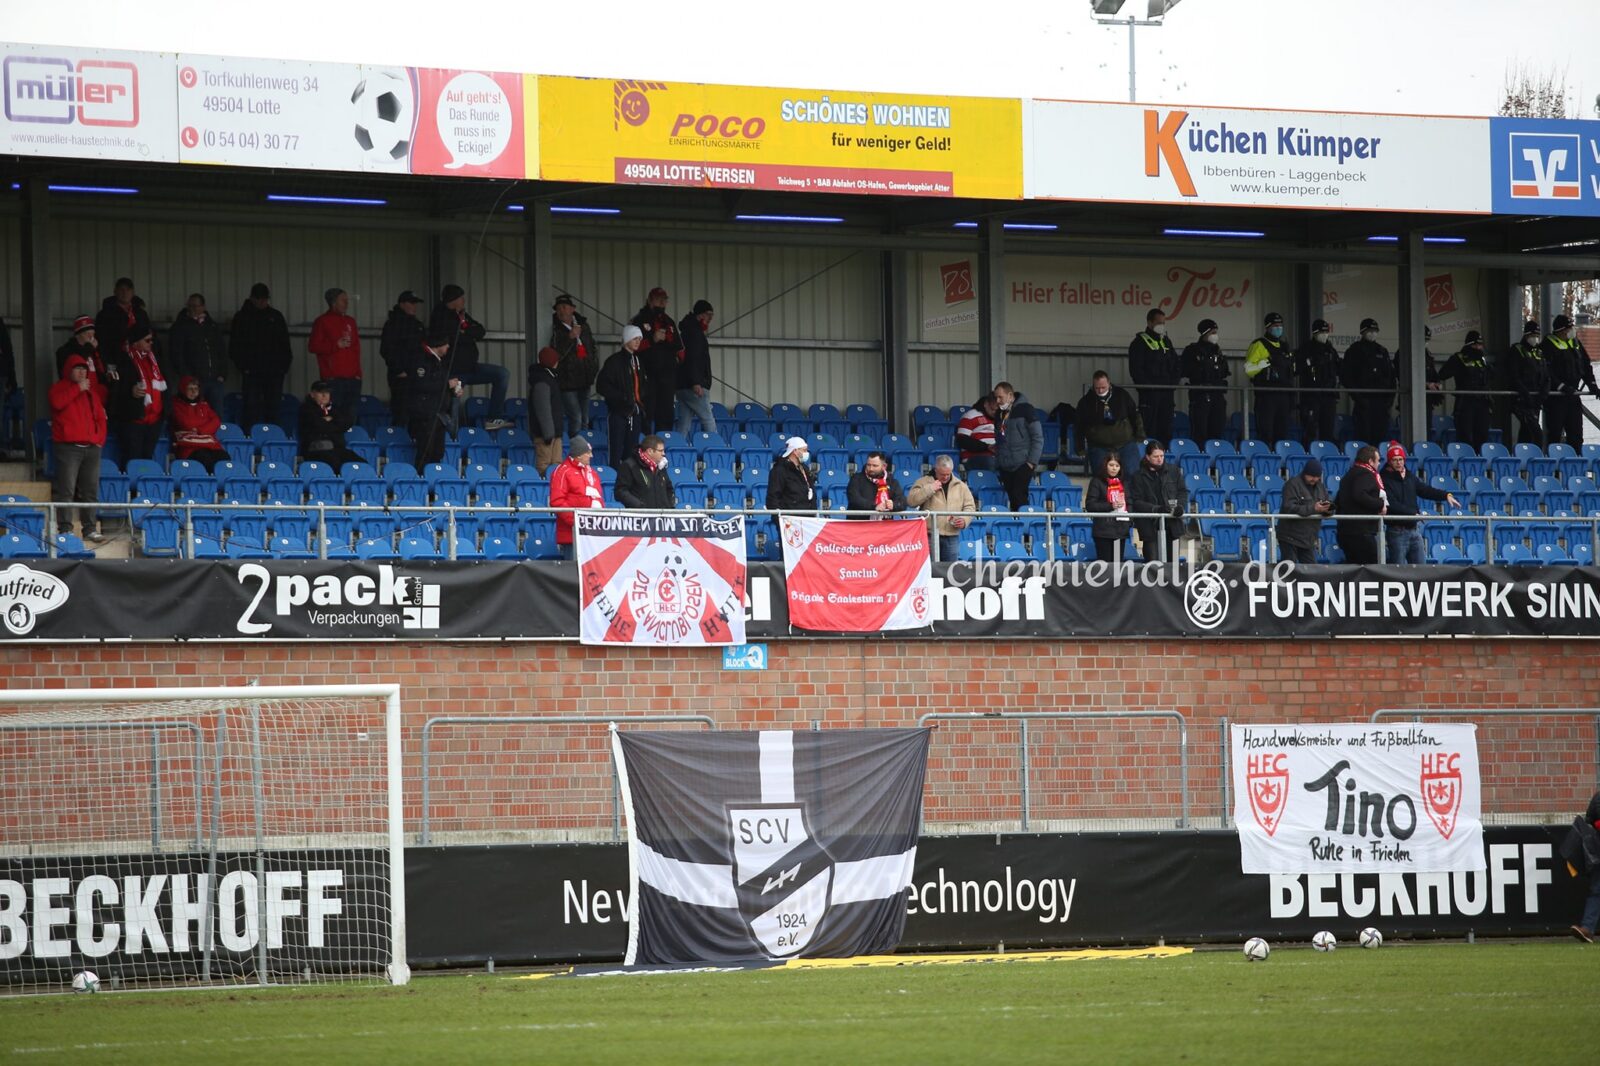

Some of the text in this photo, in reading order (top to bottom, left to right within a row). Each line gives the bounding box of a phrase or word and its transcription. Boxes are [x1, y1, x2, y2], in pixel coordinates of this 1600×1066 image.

[16, 74, 127, 104] müller
[202, 70, 319, 95] Torfkuhlenweg 34
[202, 95, 281, 115] 49504 Lotte
[446, 89, 463, 104] Auf
[449, 107, 500, 122] Das Runde
[780, 97, 951, 128] SCHÖNES WOHNEN
[453, 125, 496, 138] muss ins
[670, 113, 766, 139] POCO
[10, 133, 136, 148] www.mueller-haustechnik.de
[203, 129, 300, 151] (0 54 04) 30 77
[458, 140, 493, 156] Eckige!
[831, 132, 951, 153] für weniger Geld!
[1143, 109, 1381, 198] Küchen Kümper
[624, 163, 755, 185] 49504 LOTTE-WERSEN
[1203, 164, 1276, 180] Ibbenbüren
[1288, 168, 1367, 183] Laggenbeck
[832, 179, 856, 188] Abfahrt
[888, 181, 934, 192] Gewerbegebiet
[1230, 182, 1340, 197] www.kuemper.de
[1011, 266, 1251, 321] Hier fallen die Tore!
[925, 317, 950, 329] einfach
[815, 542, 865, 556] Hallescher
[839, 567, 879, 580] Fanclub
[413, 576, 422, 606] GmbH
[307, 609, 400, 627] Verpackungen
[1347, 732, 1366, 748] und
[1371, 728, 1443, 752] Fußballfan
[1247, 753, 1289, 774] HFC
[1421, 752, 1460, 774] HFC
[1303, 759, 1417, 841] Tino
[739, 817, 791, 845] SCV
[1309, 836, 1413, 862] Ruhe in Frieden
[0, 869, 344, 960] BECKHOFF
[776, 912, 807, 930] 1924
